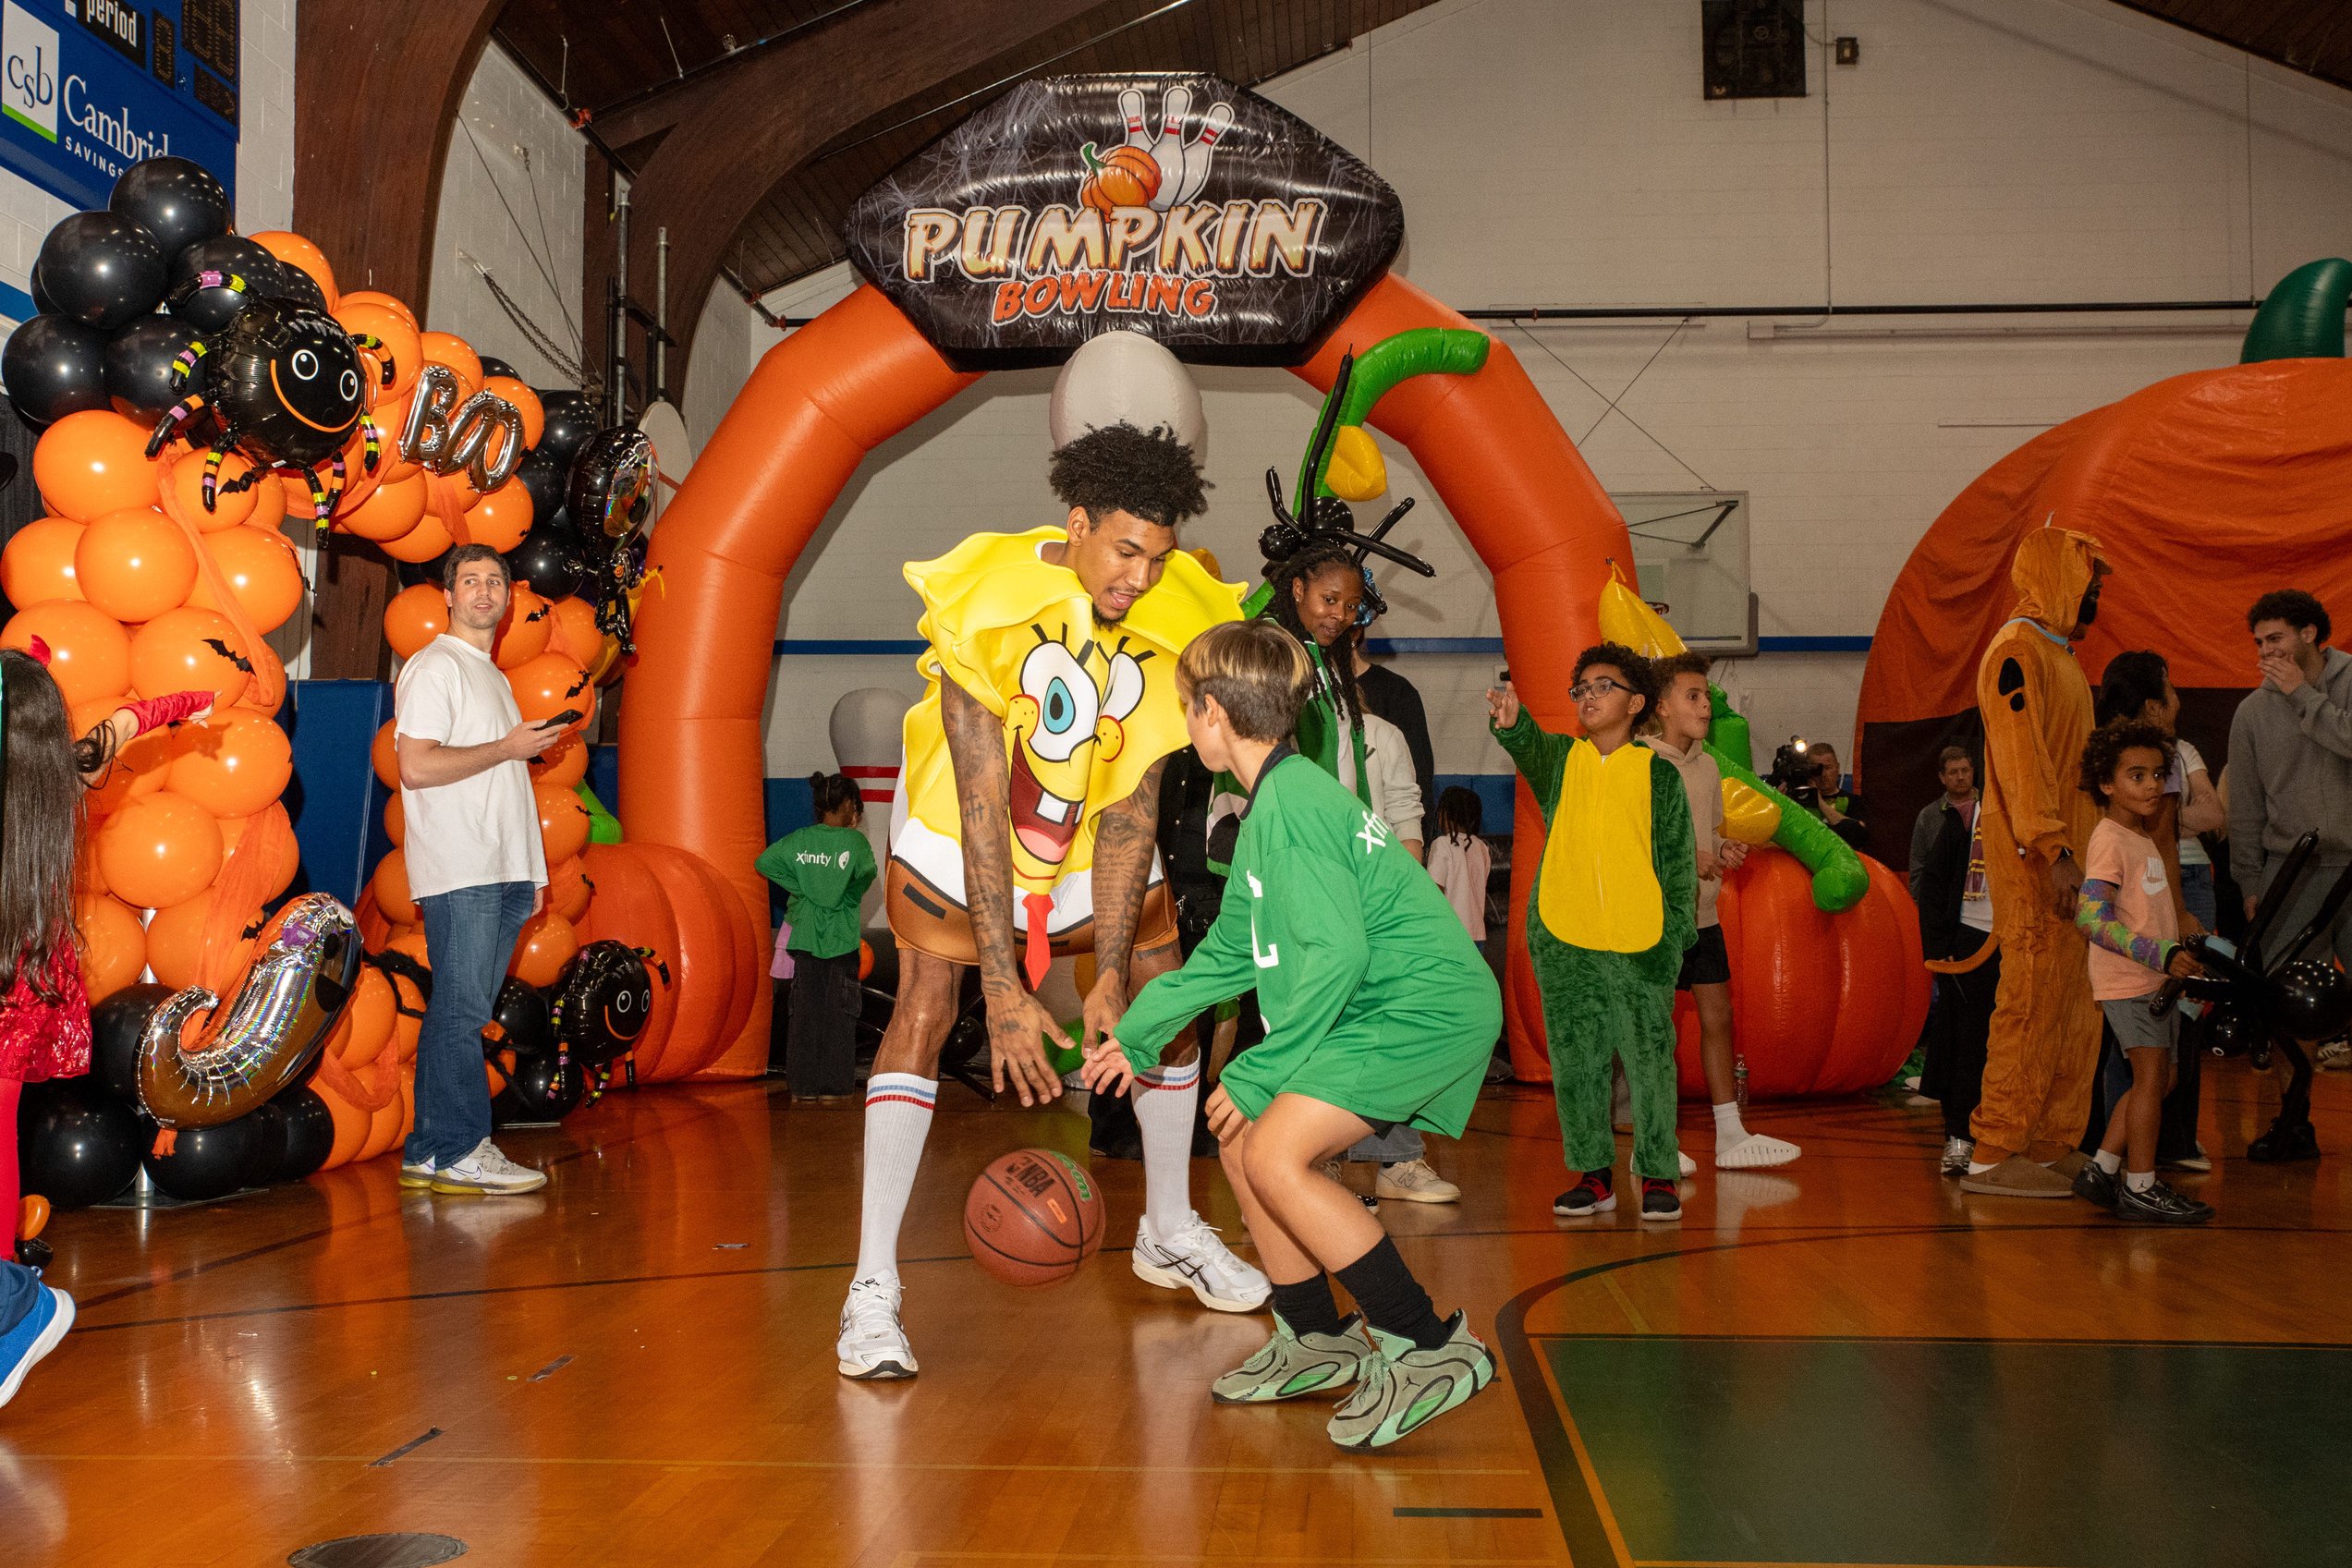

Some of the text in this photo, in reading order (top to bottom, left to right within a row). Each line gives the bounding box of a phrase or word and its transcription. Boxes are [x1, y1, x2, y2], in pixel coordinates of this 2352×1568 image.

[86, 0, 137, 47] period
[7, 45, 53, 108] csb
[903, 198, 1327, 284] PUMPKIN
[991, 272, 1219, 326] BOWLING
[397, 365, 525, 493] BOO
[796, 850, 832, 867] xfinity
[1016, 1161, 1055, 1198] NBA
